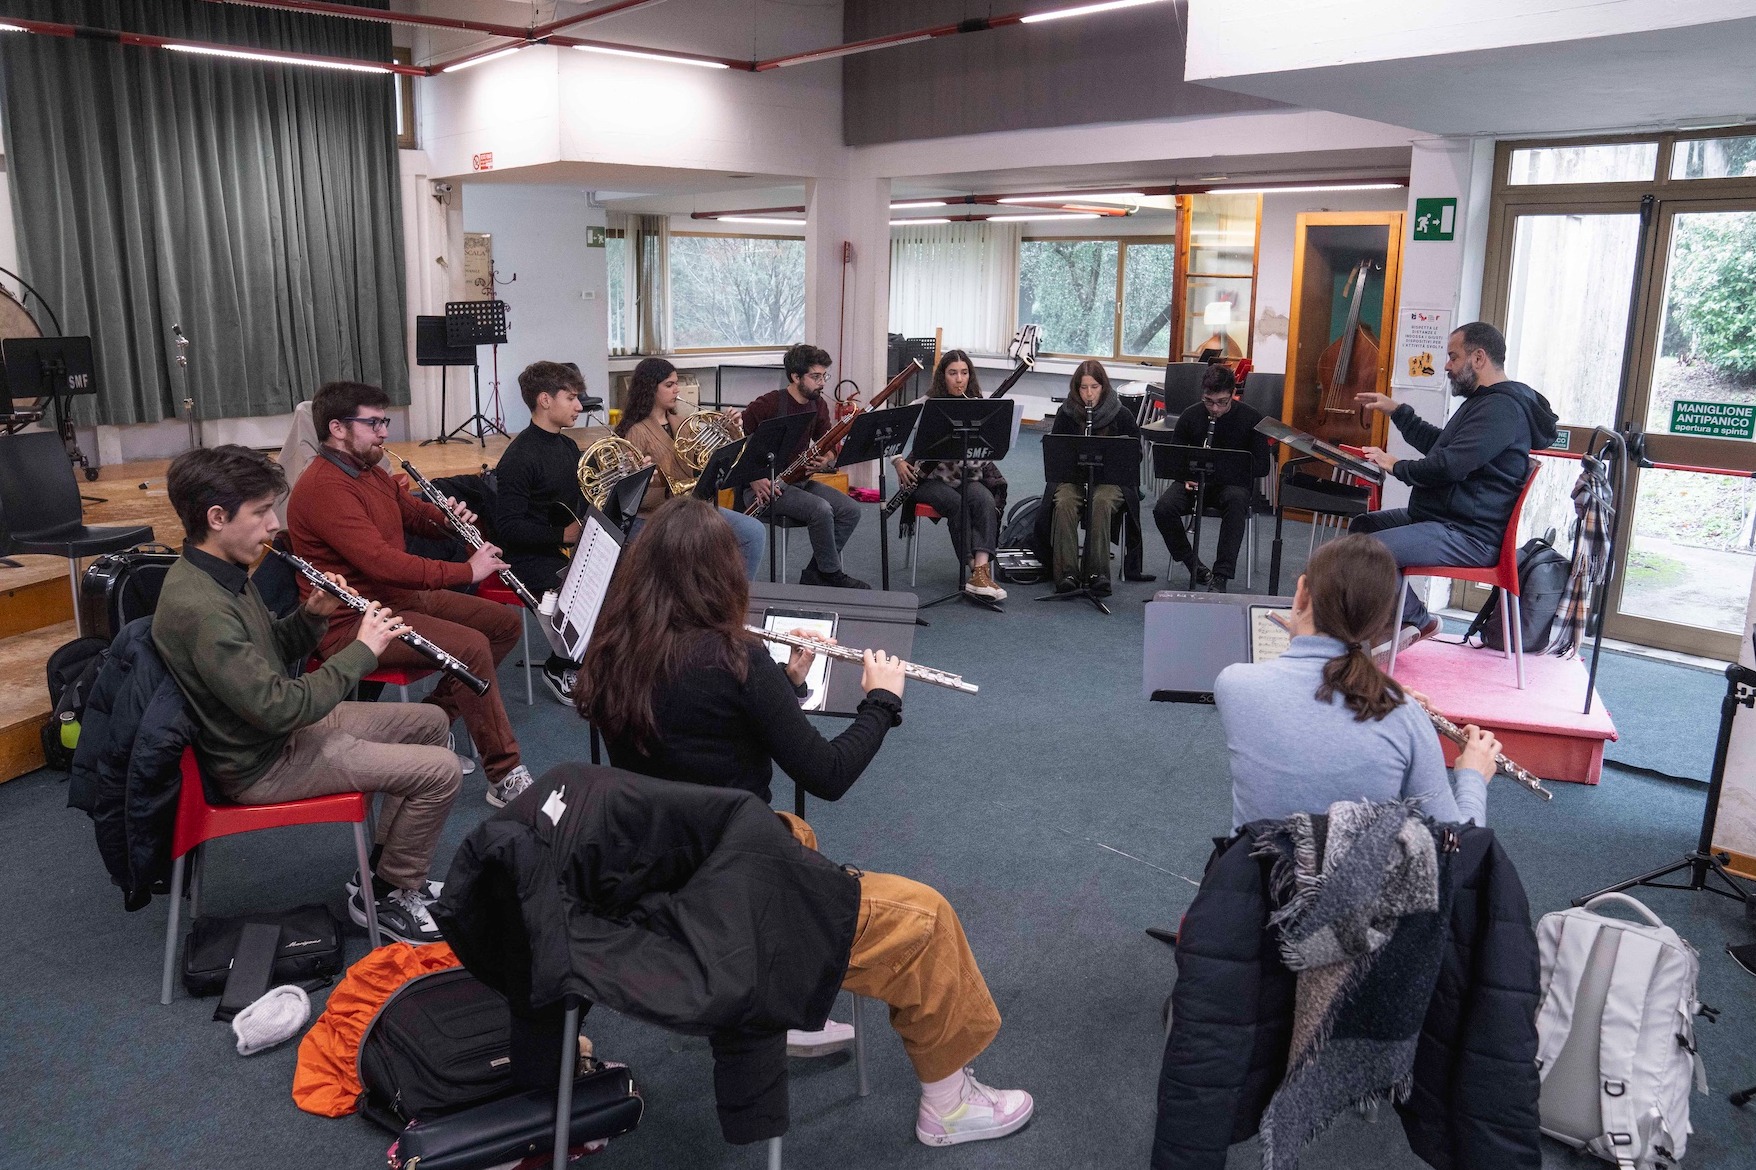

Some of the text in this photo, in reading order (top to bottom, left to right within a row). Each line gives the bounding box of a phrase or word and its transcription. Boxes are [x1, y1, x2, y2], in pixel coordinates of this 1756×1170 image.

[68, 373, 88, 389] SMF
[1676, 403, 1753, 417] MANIGLIONE
[1676, 413, 1750, 428] ANTIPANICO
[1675, 424, 1711, 433] apertura
[1720, 427, 1749, 435] spinta
[883, 443, 902, 457] SMF
